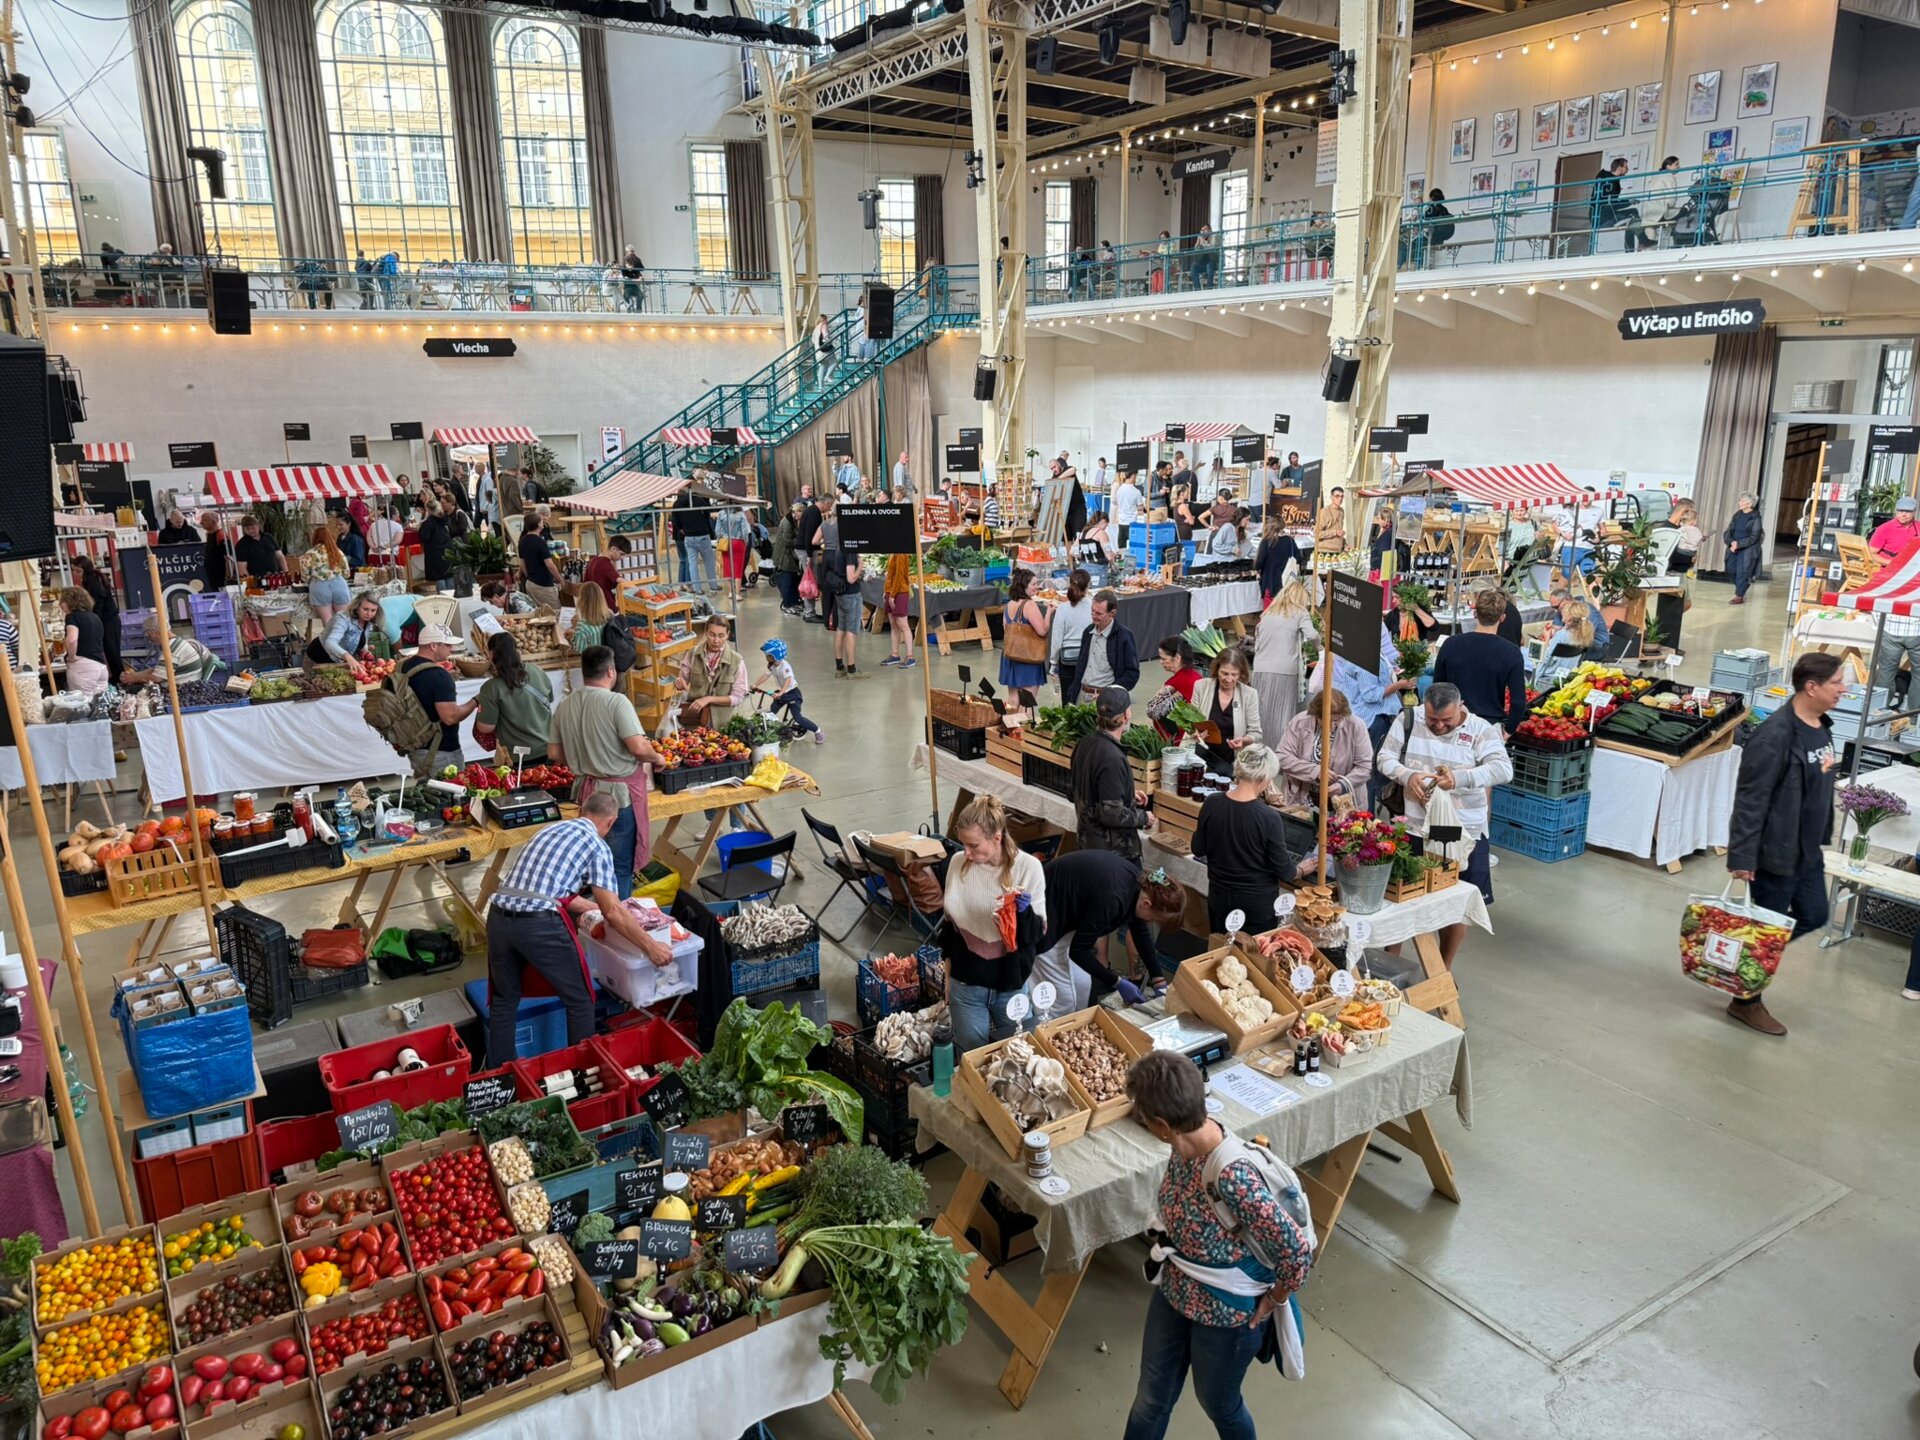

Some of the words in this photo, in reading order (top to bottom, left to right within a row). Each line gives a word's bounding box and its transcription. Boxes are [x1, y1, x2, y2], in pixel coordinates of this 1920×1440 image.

[1185, 158, 1215, 174] Kantína
[1629, 313, 1679, 334] Výčap
[1681, 316, 1692, 329] u
[1694, 308, 1753, 328] Ernőho
[452, 342, 489, 353] Viecha
[156, 554, 192, 564] VLČIE
[160, 564, 197, 574] IRUPY
[619, 1168, 659, 1181] TEKVICA
